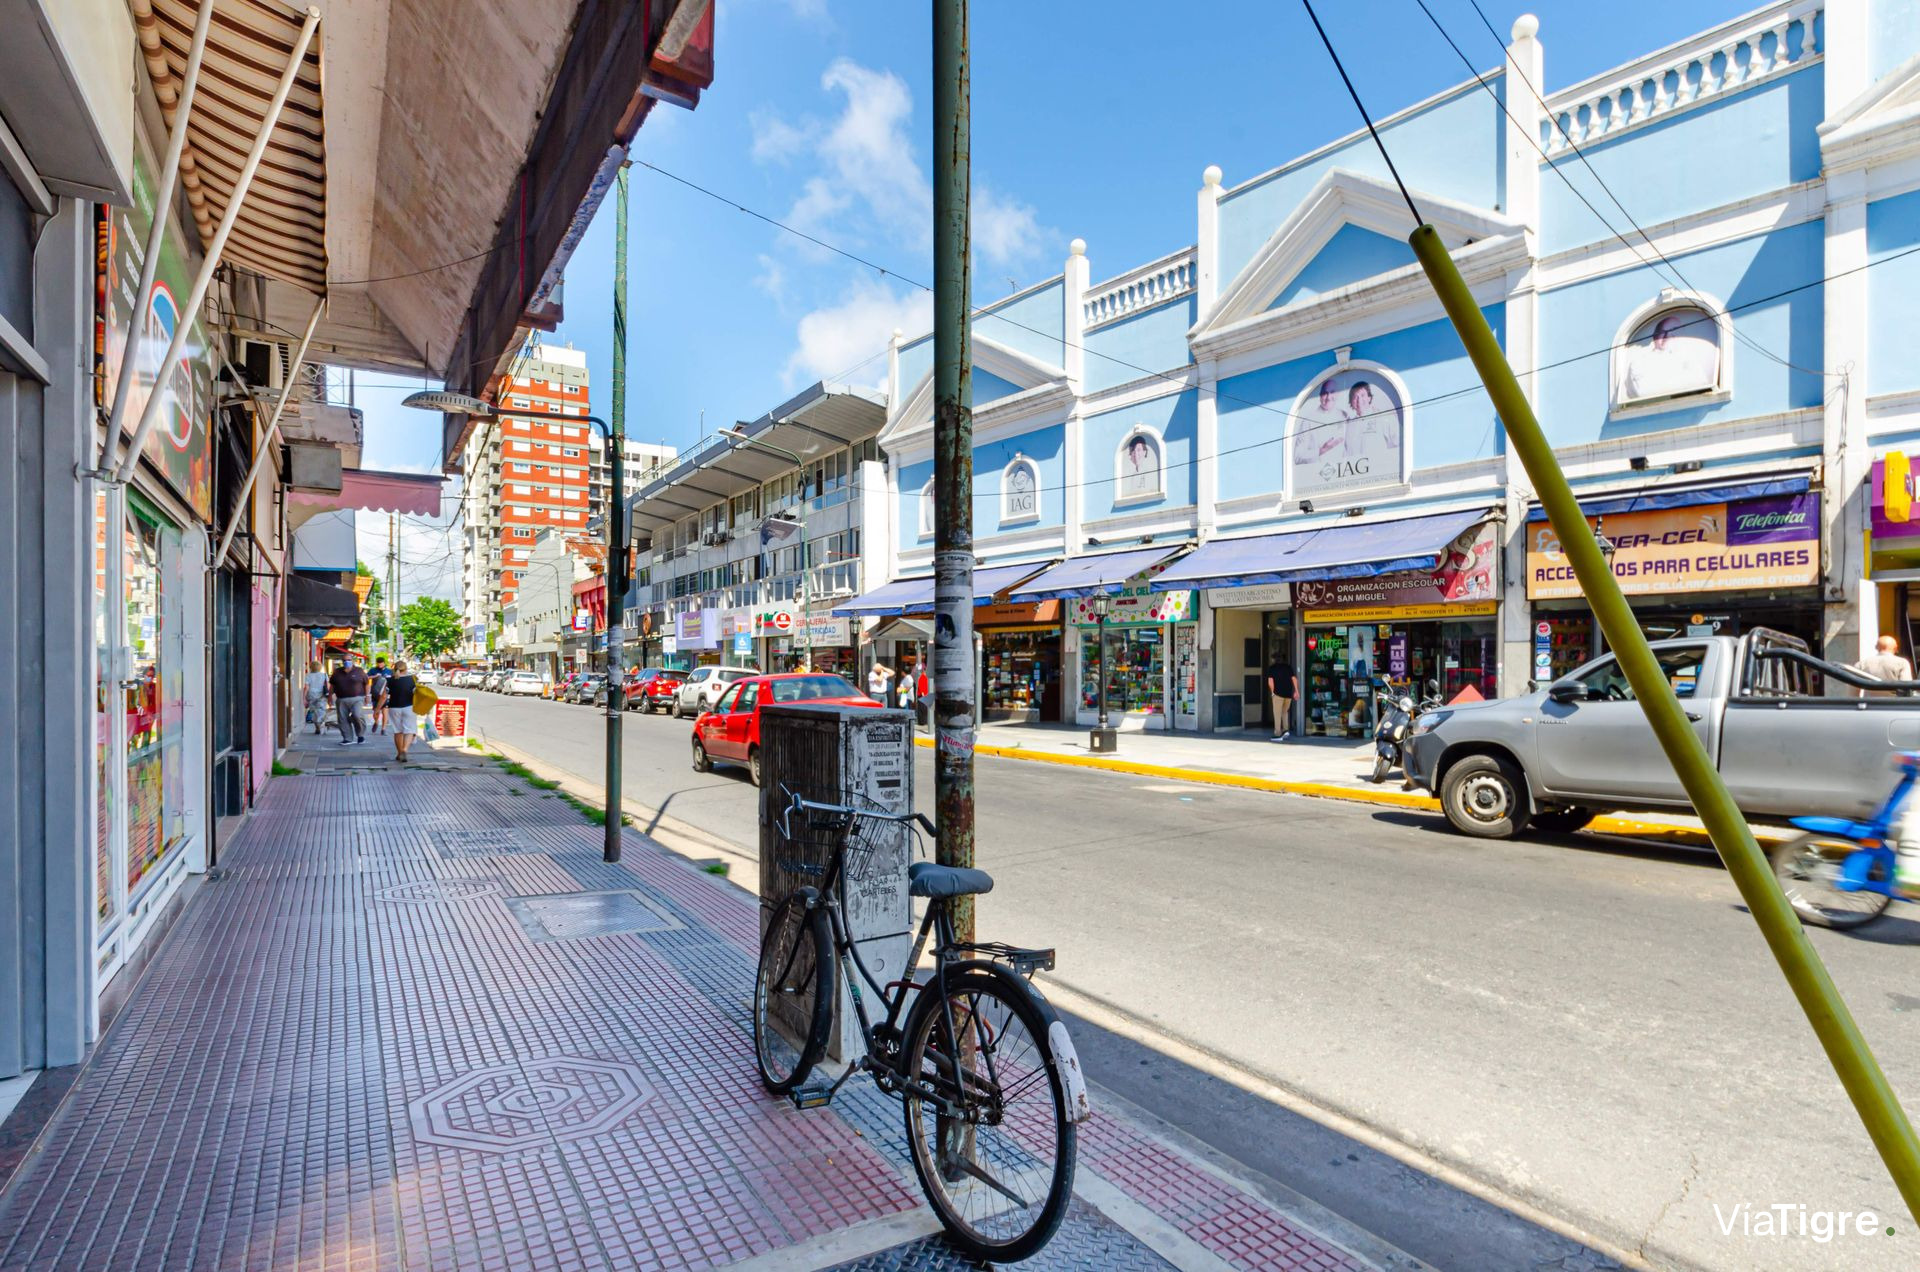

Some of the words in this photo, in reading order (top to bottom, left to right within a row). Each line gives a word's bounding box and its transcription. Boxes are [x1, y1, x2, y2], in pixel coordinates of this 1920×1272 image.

[1336, 457, 1369, 478] IAG
[1011, 495, 1032, 512] IAG
[1643, 558, 1690, 575] PARA
[1696, 549, 1810, 571] CELULARES
[1337, 581, 1400, 592] ORGANIZACION
[1402, 577, 1445, 588] ESCOLAR
[1337, 594, 1353, 602] SAN
[1356, 593, 1386, 602] MIGUEL
[1712, 621, 1721, 631] 9
